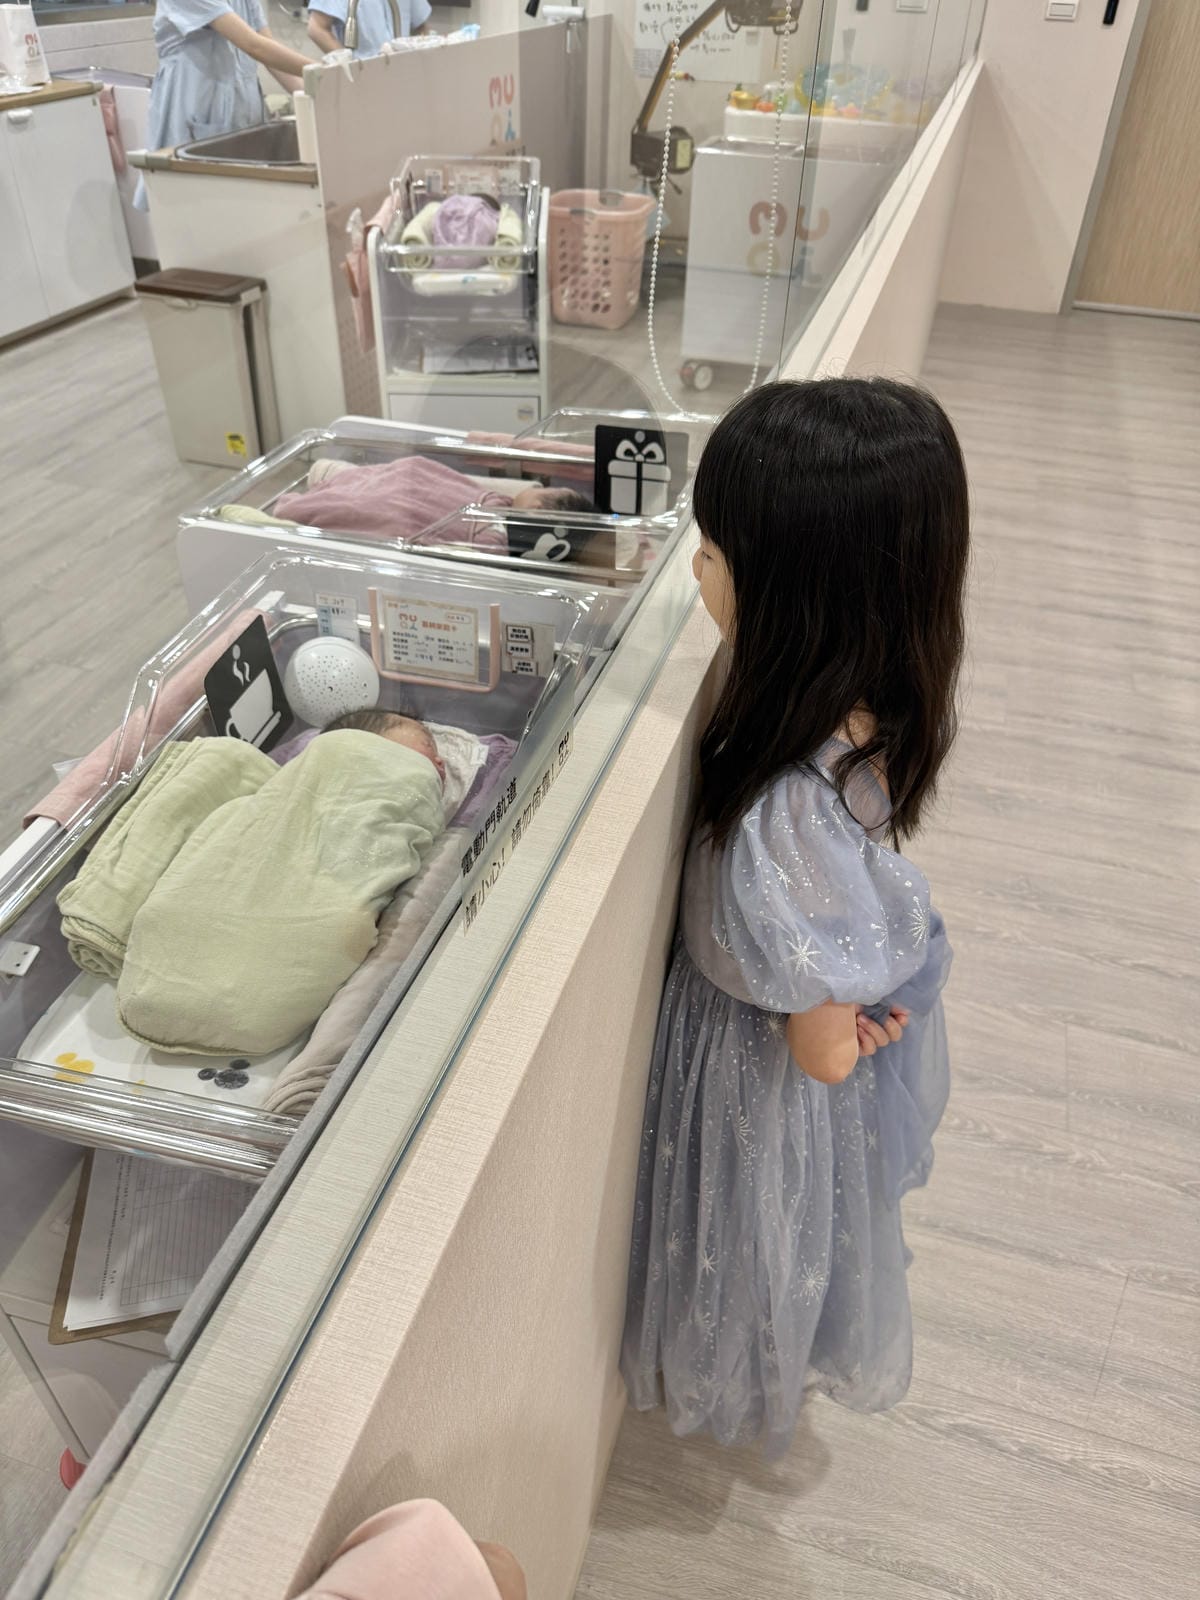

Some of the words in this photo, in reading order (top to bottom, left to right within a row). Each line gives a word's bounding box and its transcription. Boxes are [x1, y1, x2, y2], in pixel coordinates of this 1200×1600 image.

[461, 776, 518, 878] 電動門軌道
